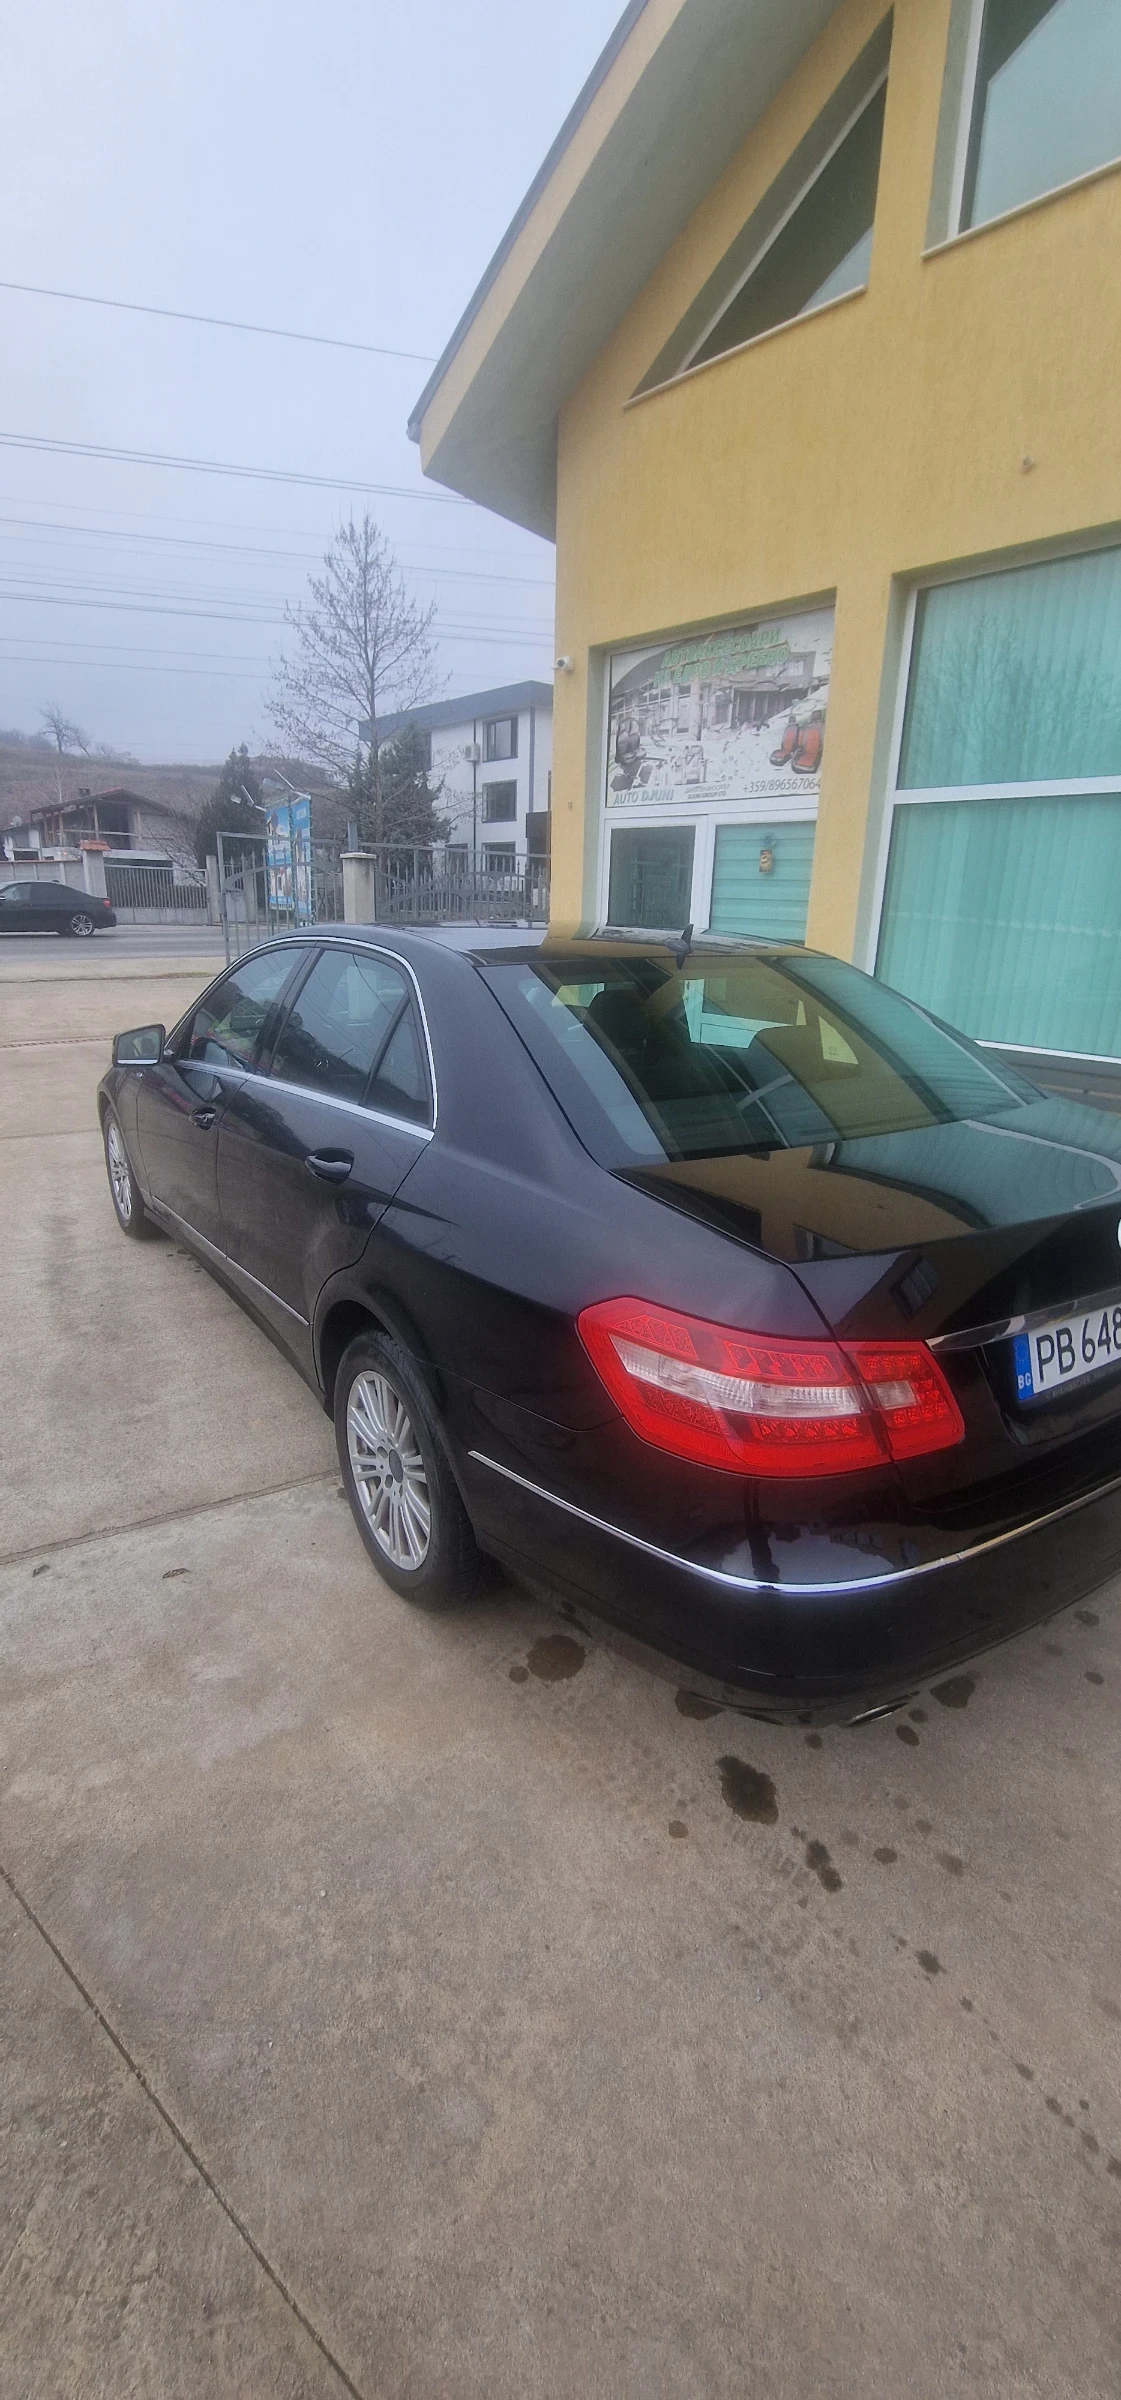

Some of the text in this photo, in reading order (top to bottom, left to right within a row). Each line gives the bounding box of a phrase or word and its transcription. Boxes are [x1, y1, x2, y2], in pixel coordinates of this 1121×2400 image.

[613, 791, 639, 806] AUTO
[1036, 1327, 1076, 1383] PB
[1081, 1307, 1121, 1363] 648
[1017, 1372, 1032, 1390] BG
